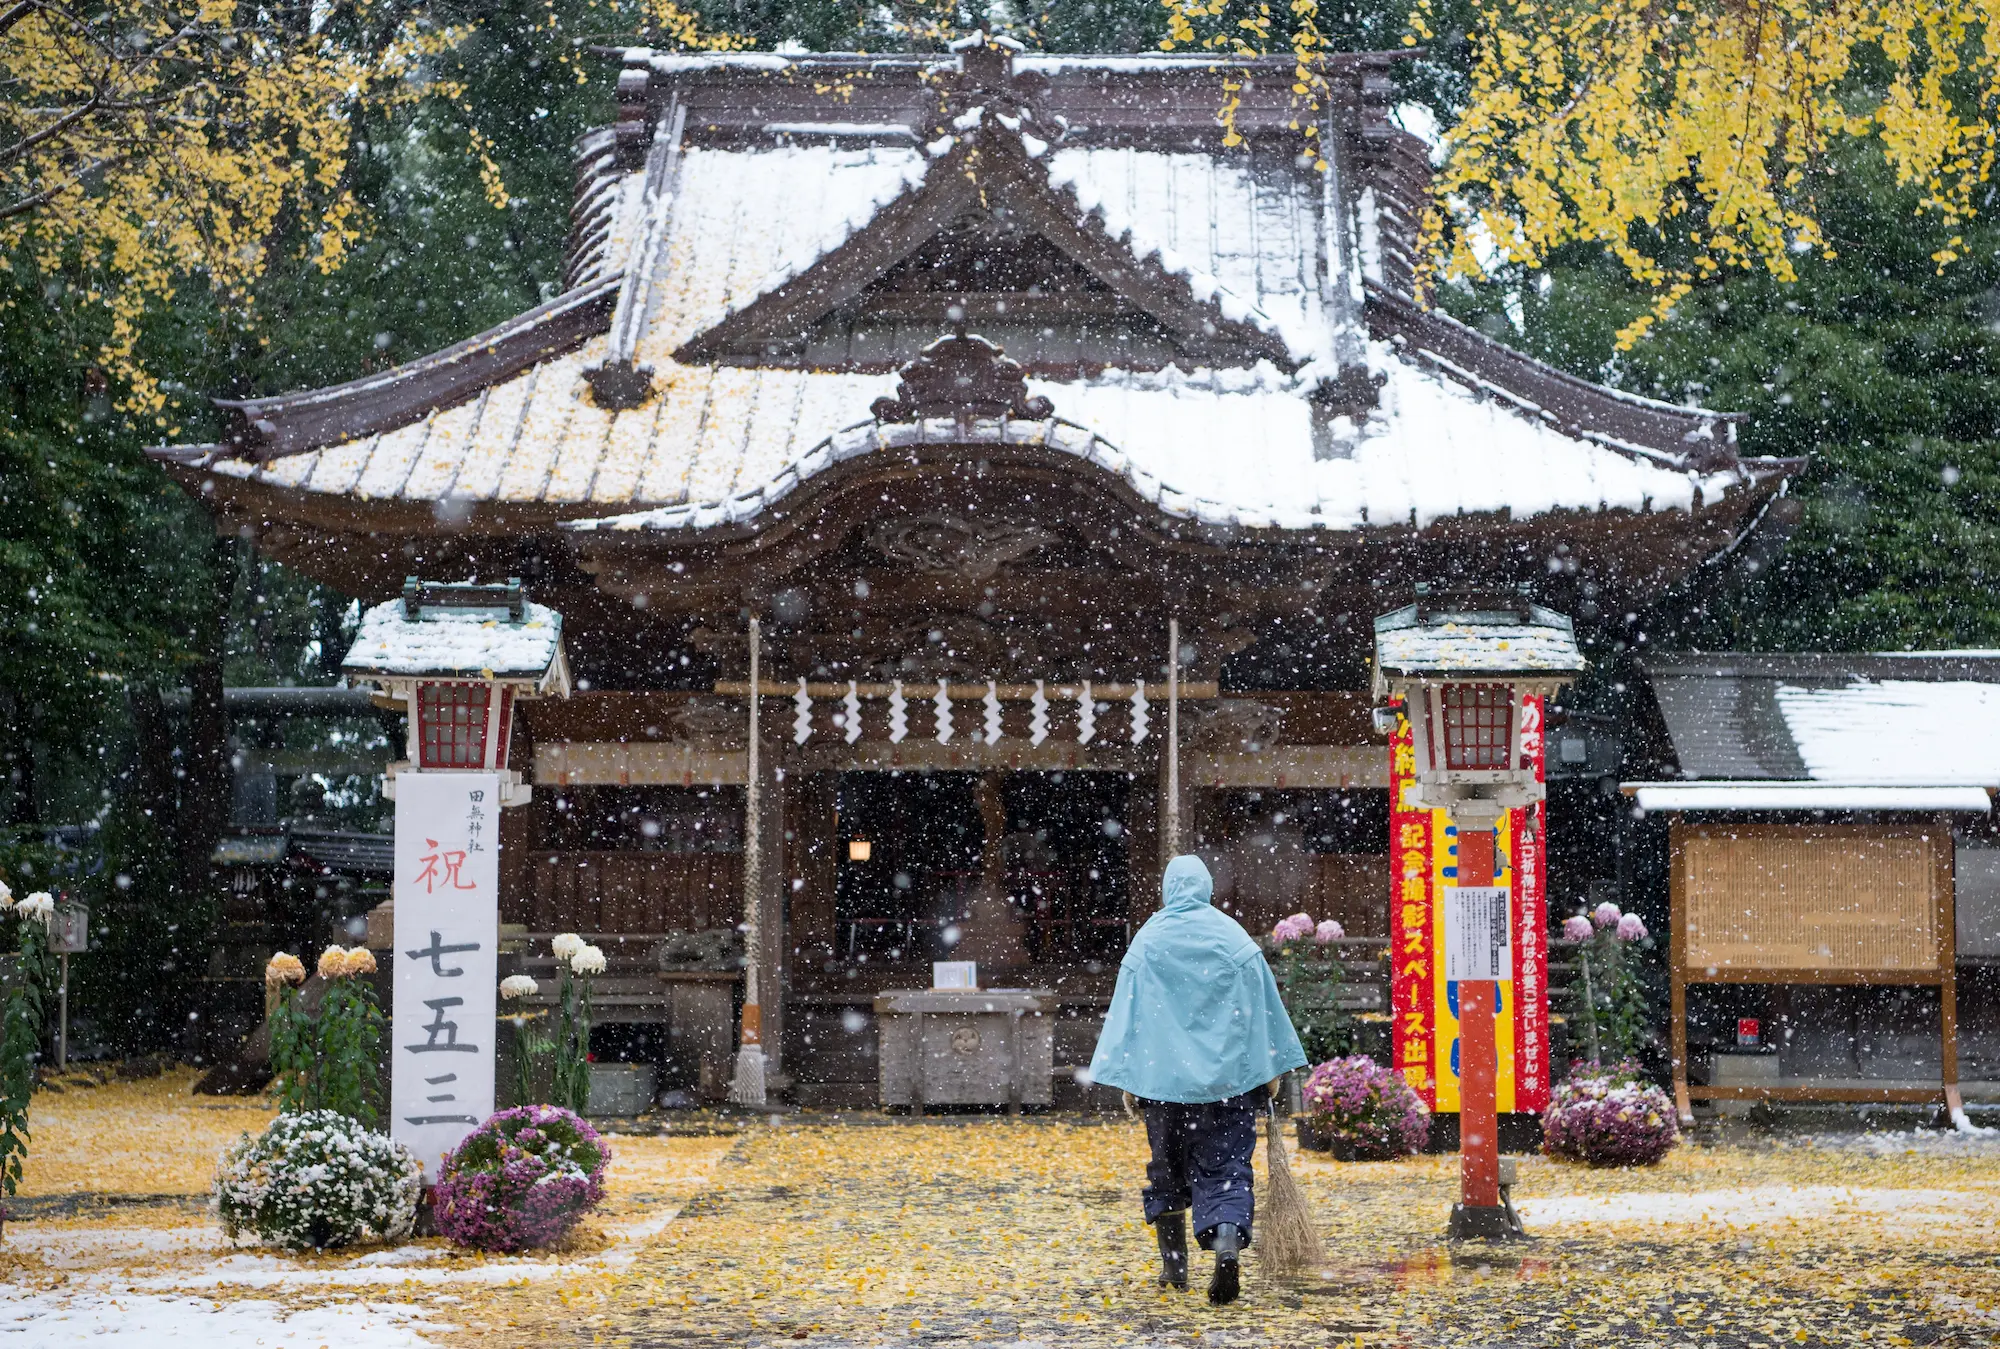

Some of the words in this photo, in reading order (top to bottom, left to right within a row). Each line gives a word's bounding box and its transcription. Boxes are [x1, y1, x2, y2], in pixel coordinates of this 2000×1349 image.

[412, 838, 477, 894] 祝
[466, 790, 485, 854] 田無神社
[1401, 823, 1428, 1090] 記念撮影スペース出現
[404, 930, 481, 1126] 七五三
